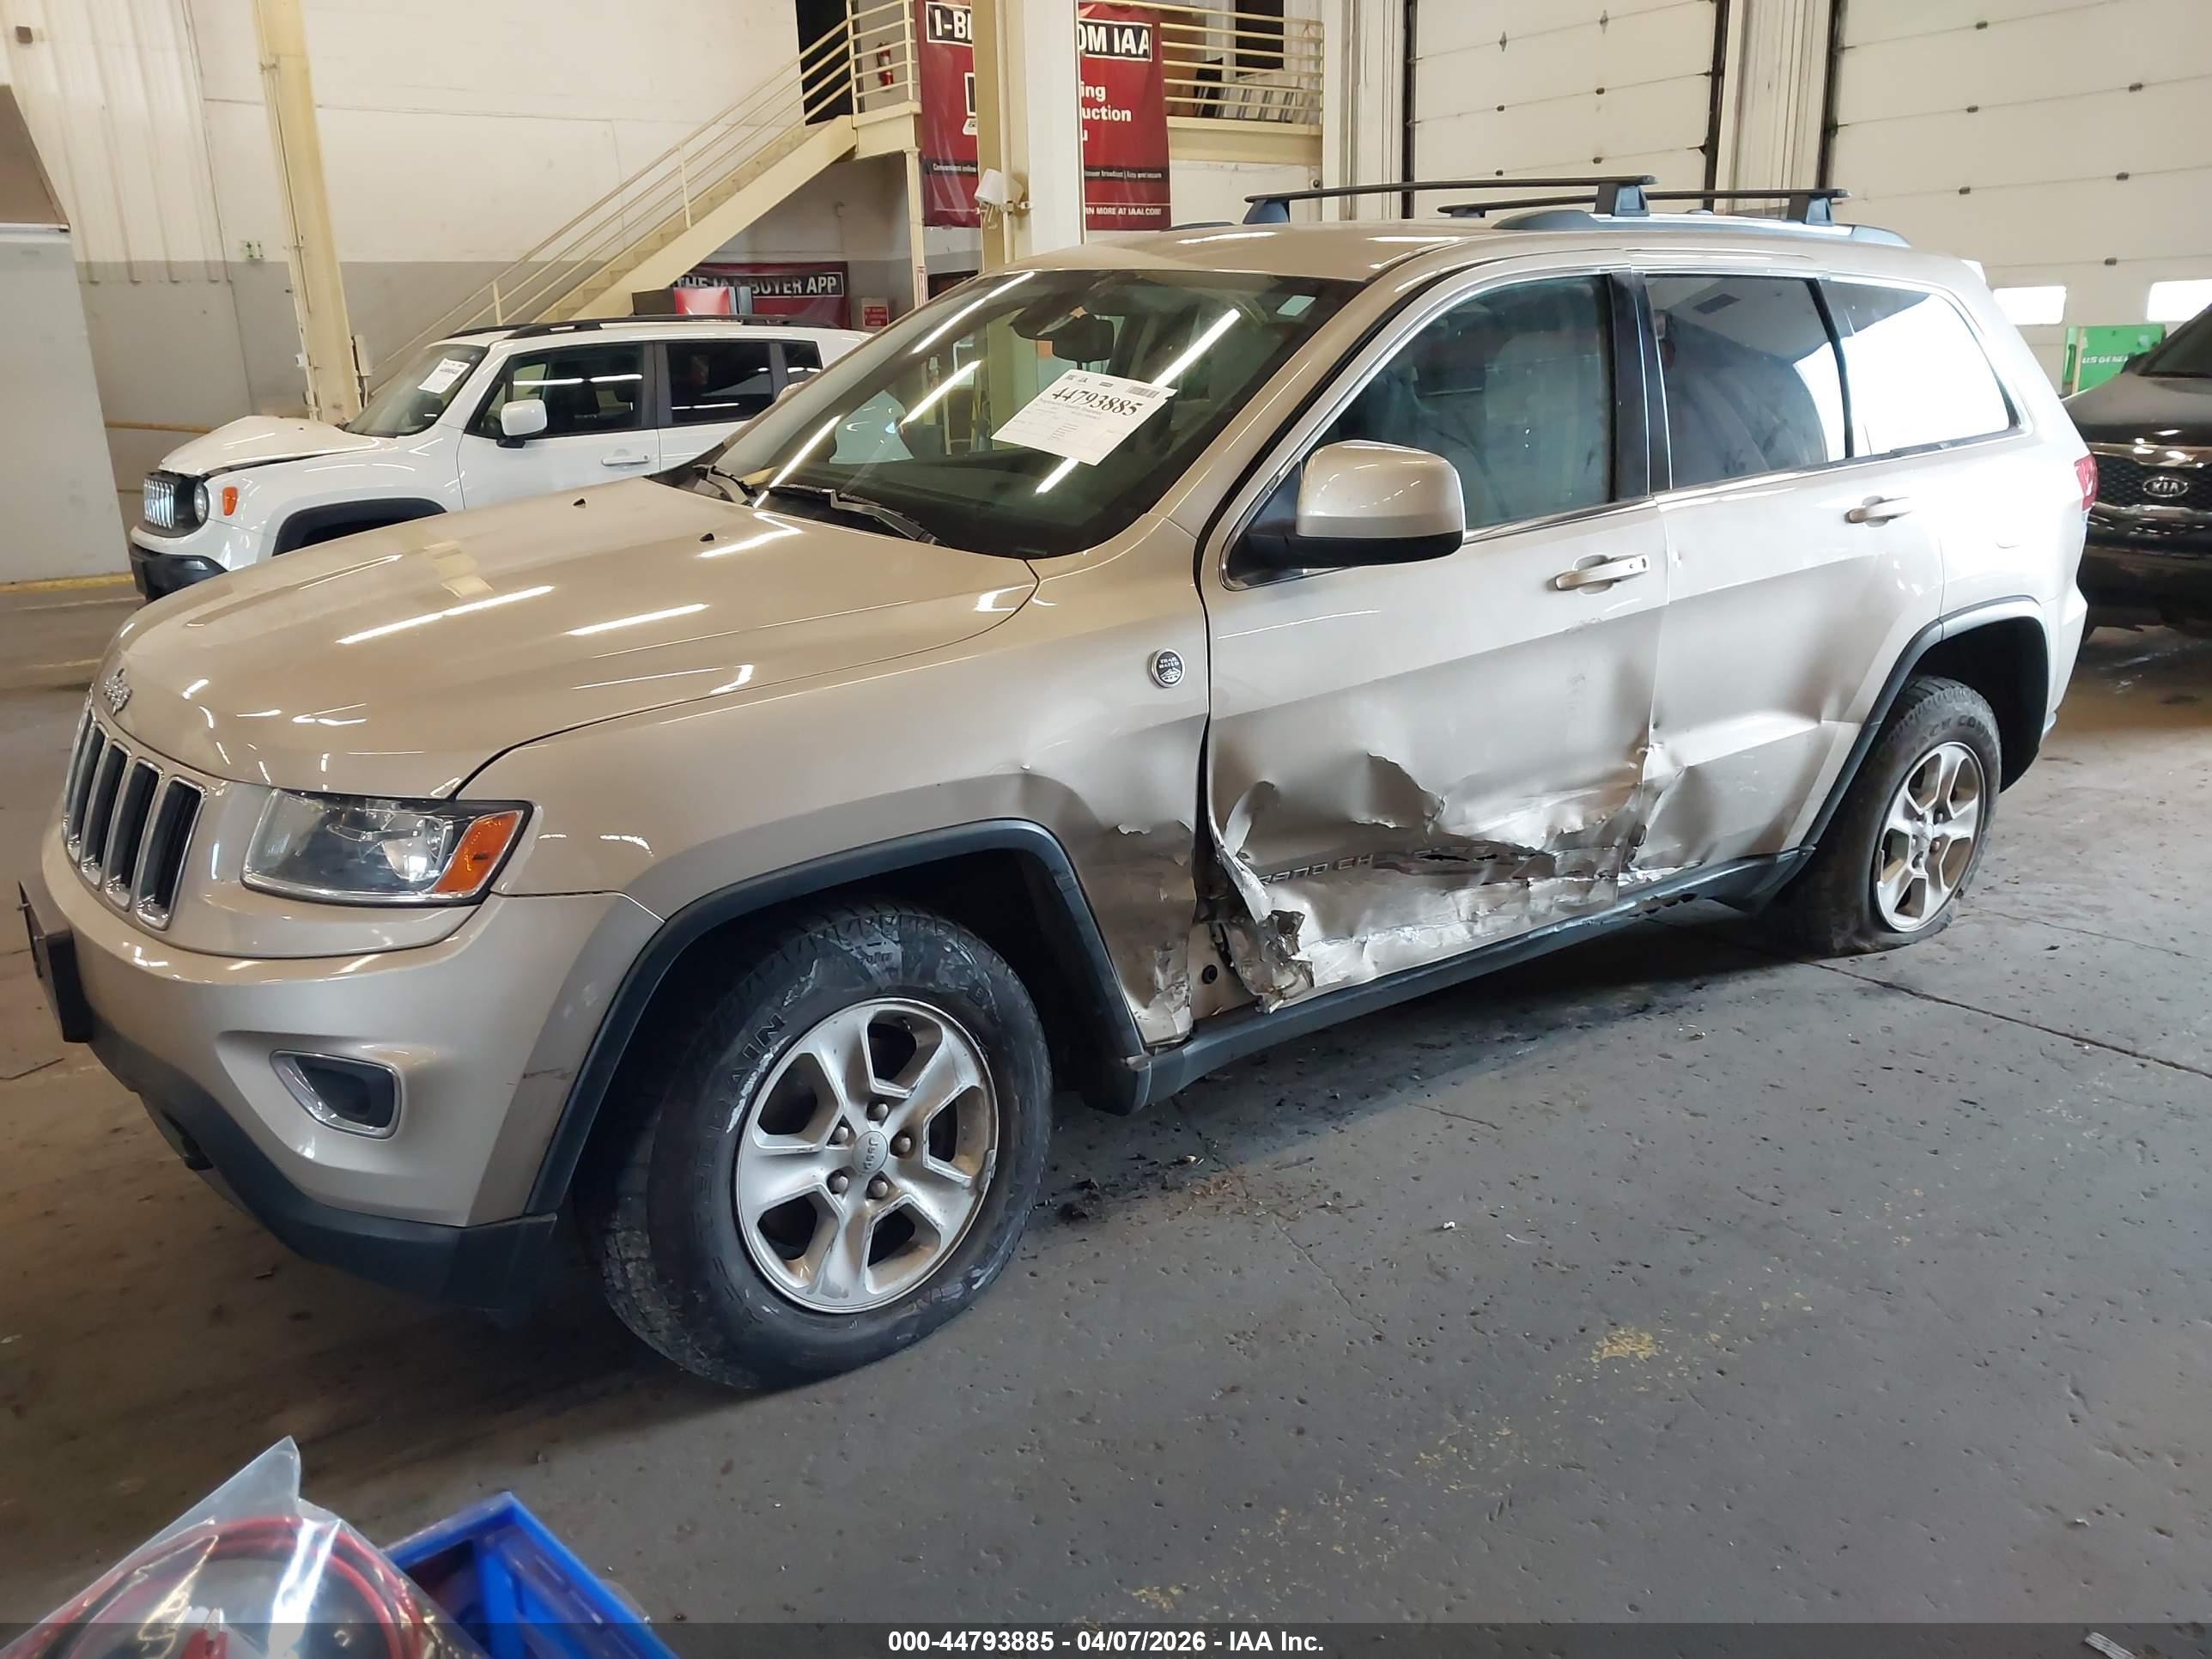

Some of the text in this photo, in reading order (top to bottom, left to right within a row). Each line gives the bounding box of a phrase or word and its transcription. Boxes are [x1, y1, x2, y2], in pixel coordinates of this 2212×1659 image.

[1113, 28, 1150, 55] IAA
[1096, 207, 1116, 216] MORE
[806, 276, 837, 294] APP
[1052, 387, 1144, 416] 44793885
[2152, 482, 2179, 494] KIA
